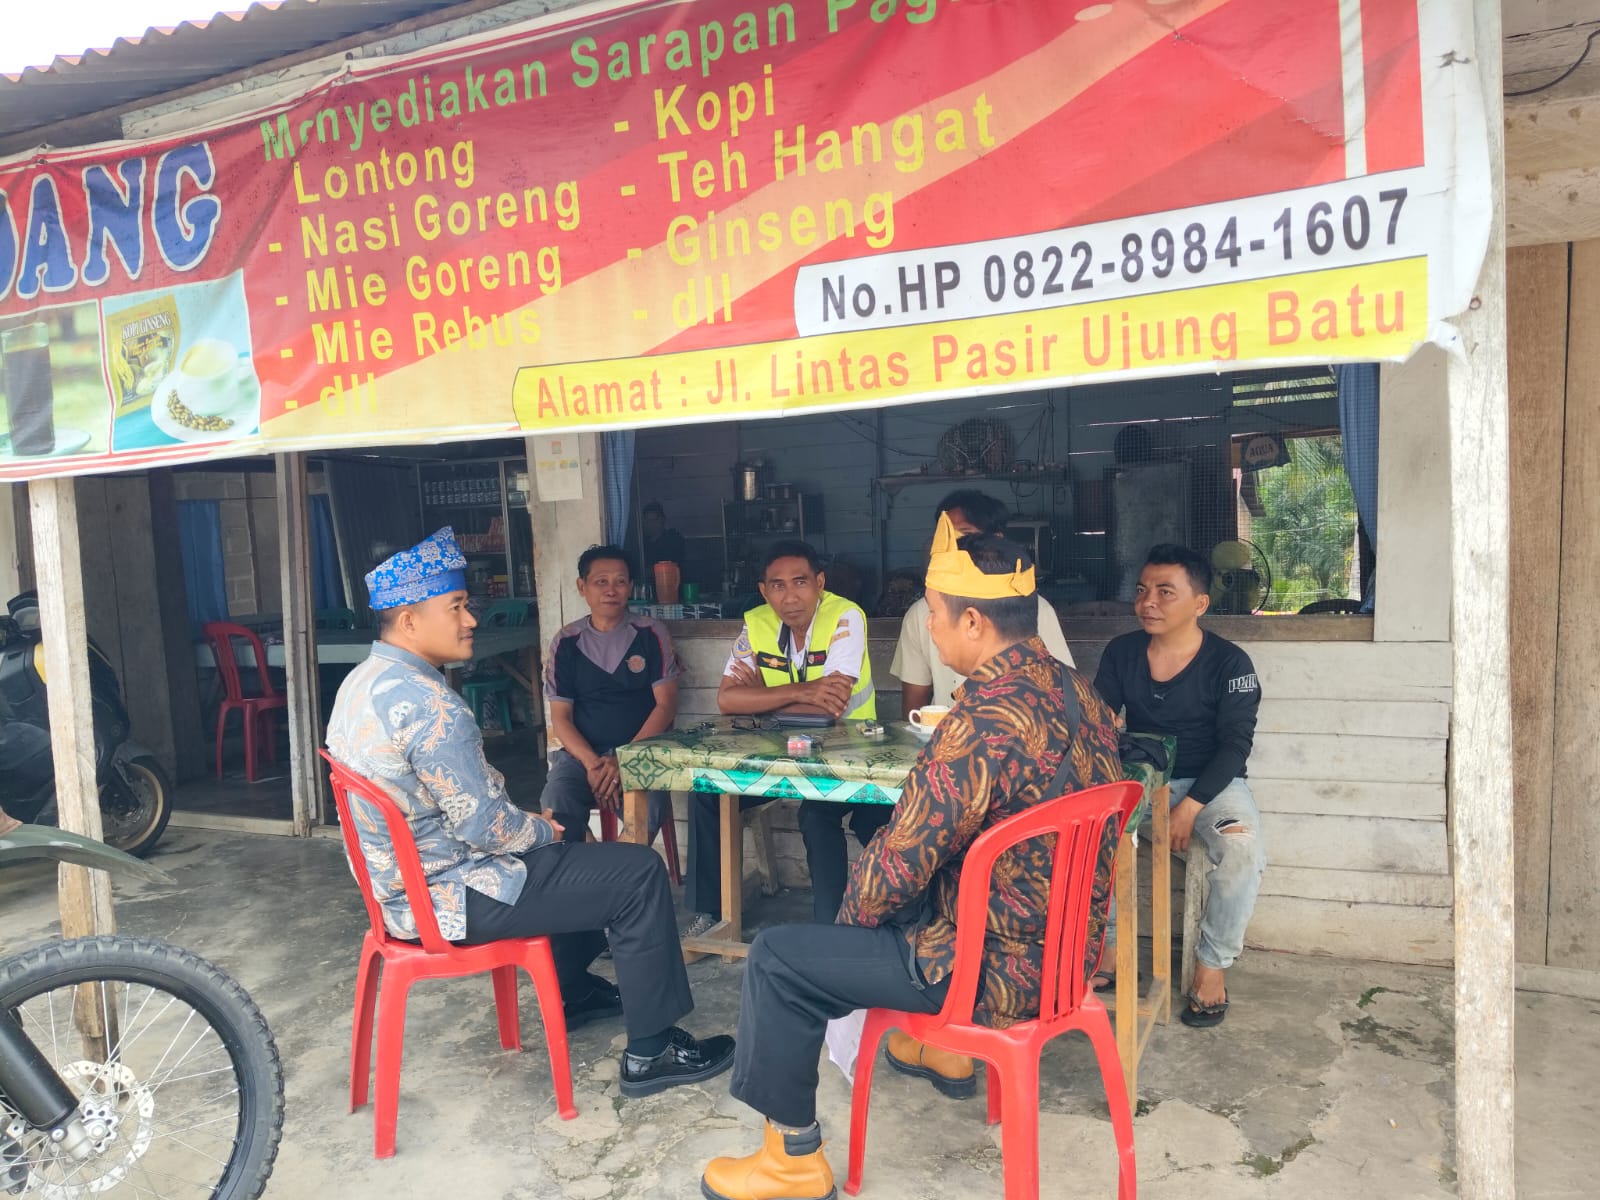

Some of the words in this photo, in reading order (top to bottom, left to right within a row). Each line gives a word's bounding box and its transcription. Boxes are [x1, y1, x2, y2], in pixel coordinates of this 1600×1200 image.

[571, 2, 797, 89] Sarapan
[655, 64, 774, 138] Kopi
[293, 140, 475, 204] Lontong
[658, 142, 748, 203] Teh
[774, 92, 995, 181] Hangat
[301, 203, 401, 259] Nasi
[415, 181, 580, 241] Goreng
[666, 191, 895, 266] Ginseng
[821, 260, 961, 322] No.HP
[983, 187, 1409, 301] 0822-8984-1607
[306, 265, 387, 312] Mie
[406, 246, 562, 301] Goreng
[672, 274, 734, 327] dll
[312, 320, 394, 365] Mie
[413, 306, 540, 356] Rebus
[538, 370, 662, 419] Alamat
[706, 359, 751, 404] Jl.
[771, 348, 910, 396] Lintas
[933, 325, 1059, 382] Pasir
[1082, 311, 1239, 370] Ujung
[1267, 283, 1406, 346] Batu
[320, 373, 378, 415] dll
